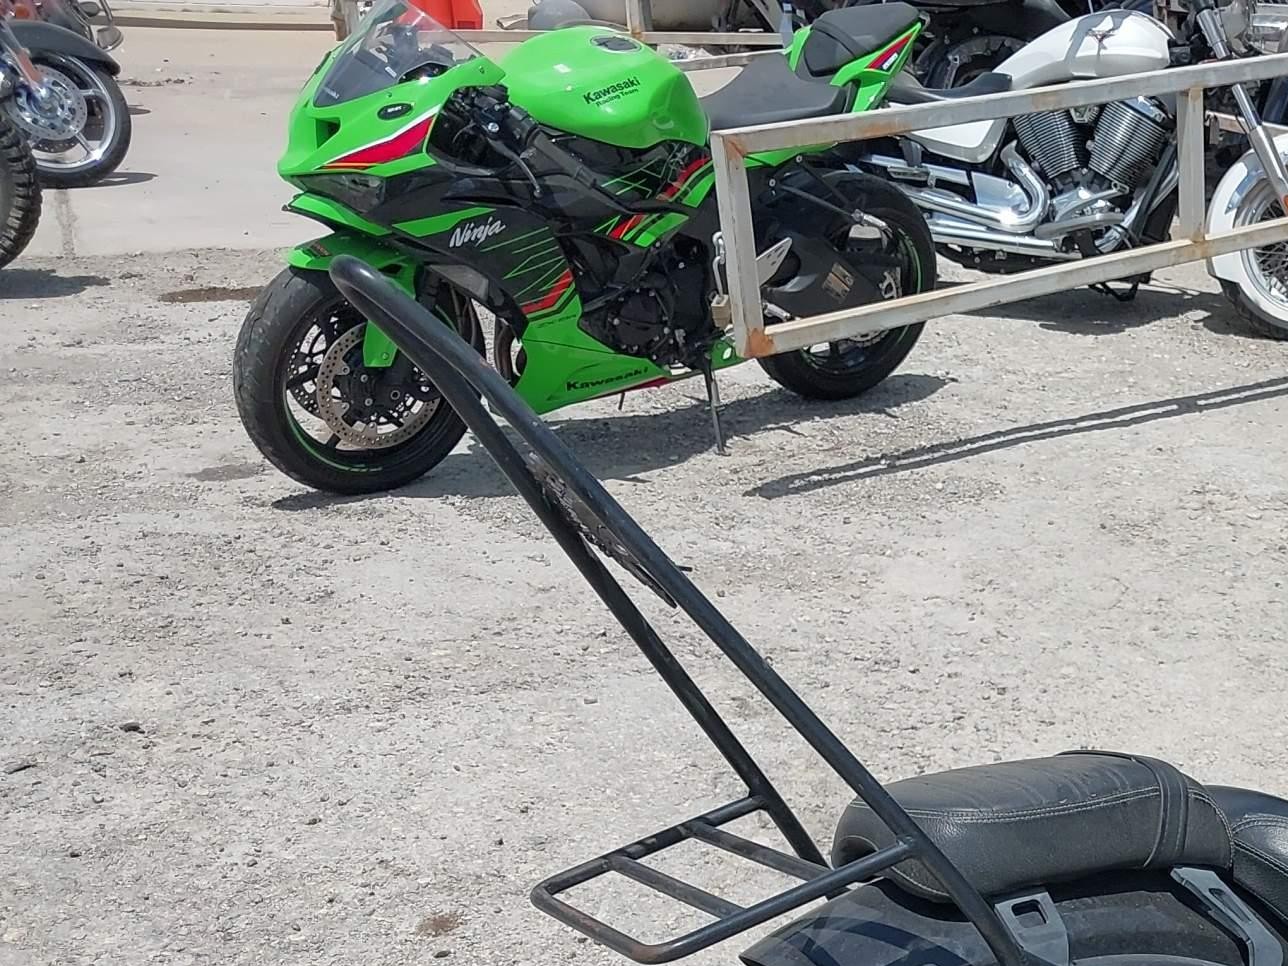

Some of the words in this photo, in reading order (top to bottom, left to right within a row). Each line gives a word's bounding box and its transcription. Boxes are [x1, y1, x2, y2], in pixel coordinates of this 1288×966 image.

[583, 76, 641, 104] Kawasaki
[595, 95, 621, 107] Racing
[620, 88, 639, 97] Team
[449, 216, 506, 248] Ninja
[566, 367, 649, 391] Kawasaki
